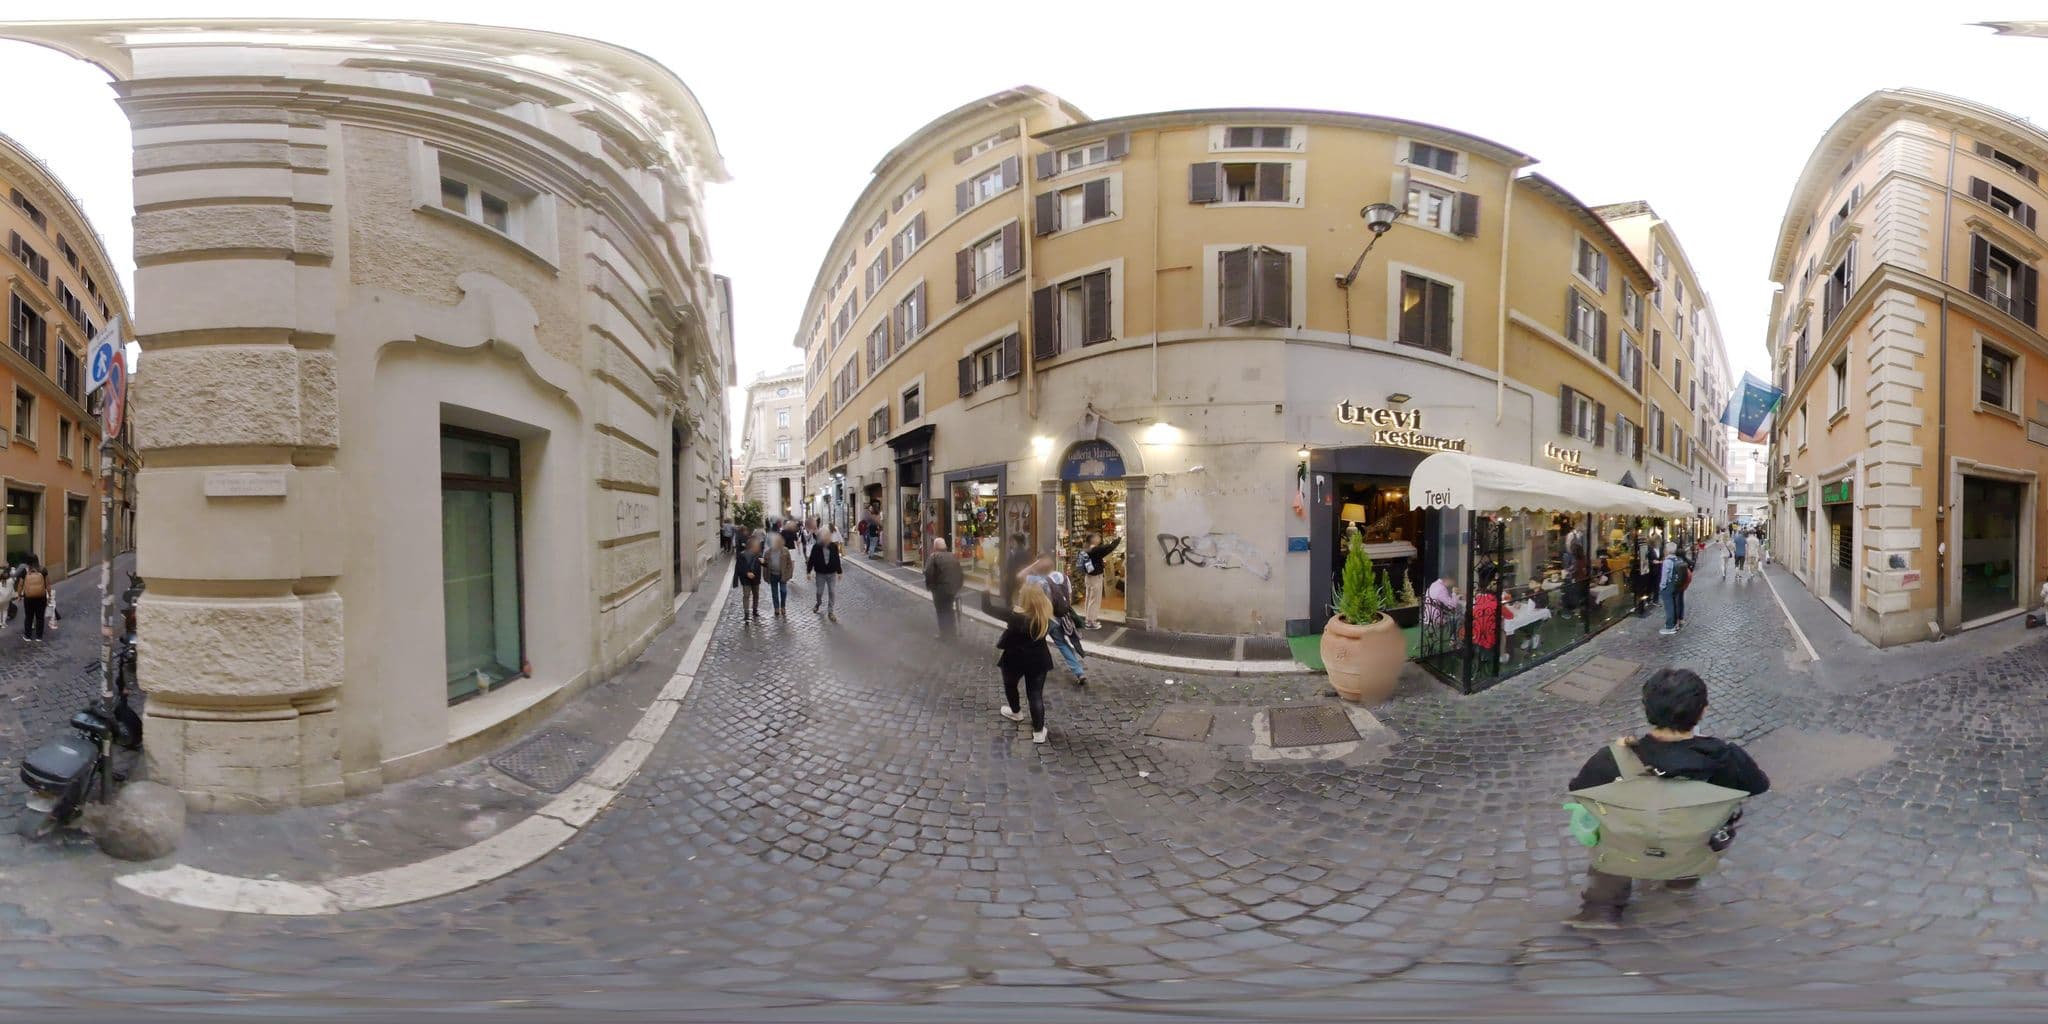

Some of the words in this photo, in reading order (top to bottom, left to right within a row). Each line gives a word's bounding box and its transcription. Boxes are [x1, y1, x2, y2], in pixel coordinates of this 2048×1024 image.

[1337, 399, 1421, 430] trevi
[1374, 430, 1465, 452] restaurant
[1545, 441, 1581, 463] trevi
[1425, 487, 1451, 505] Trevi
